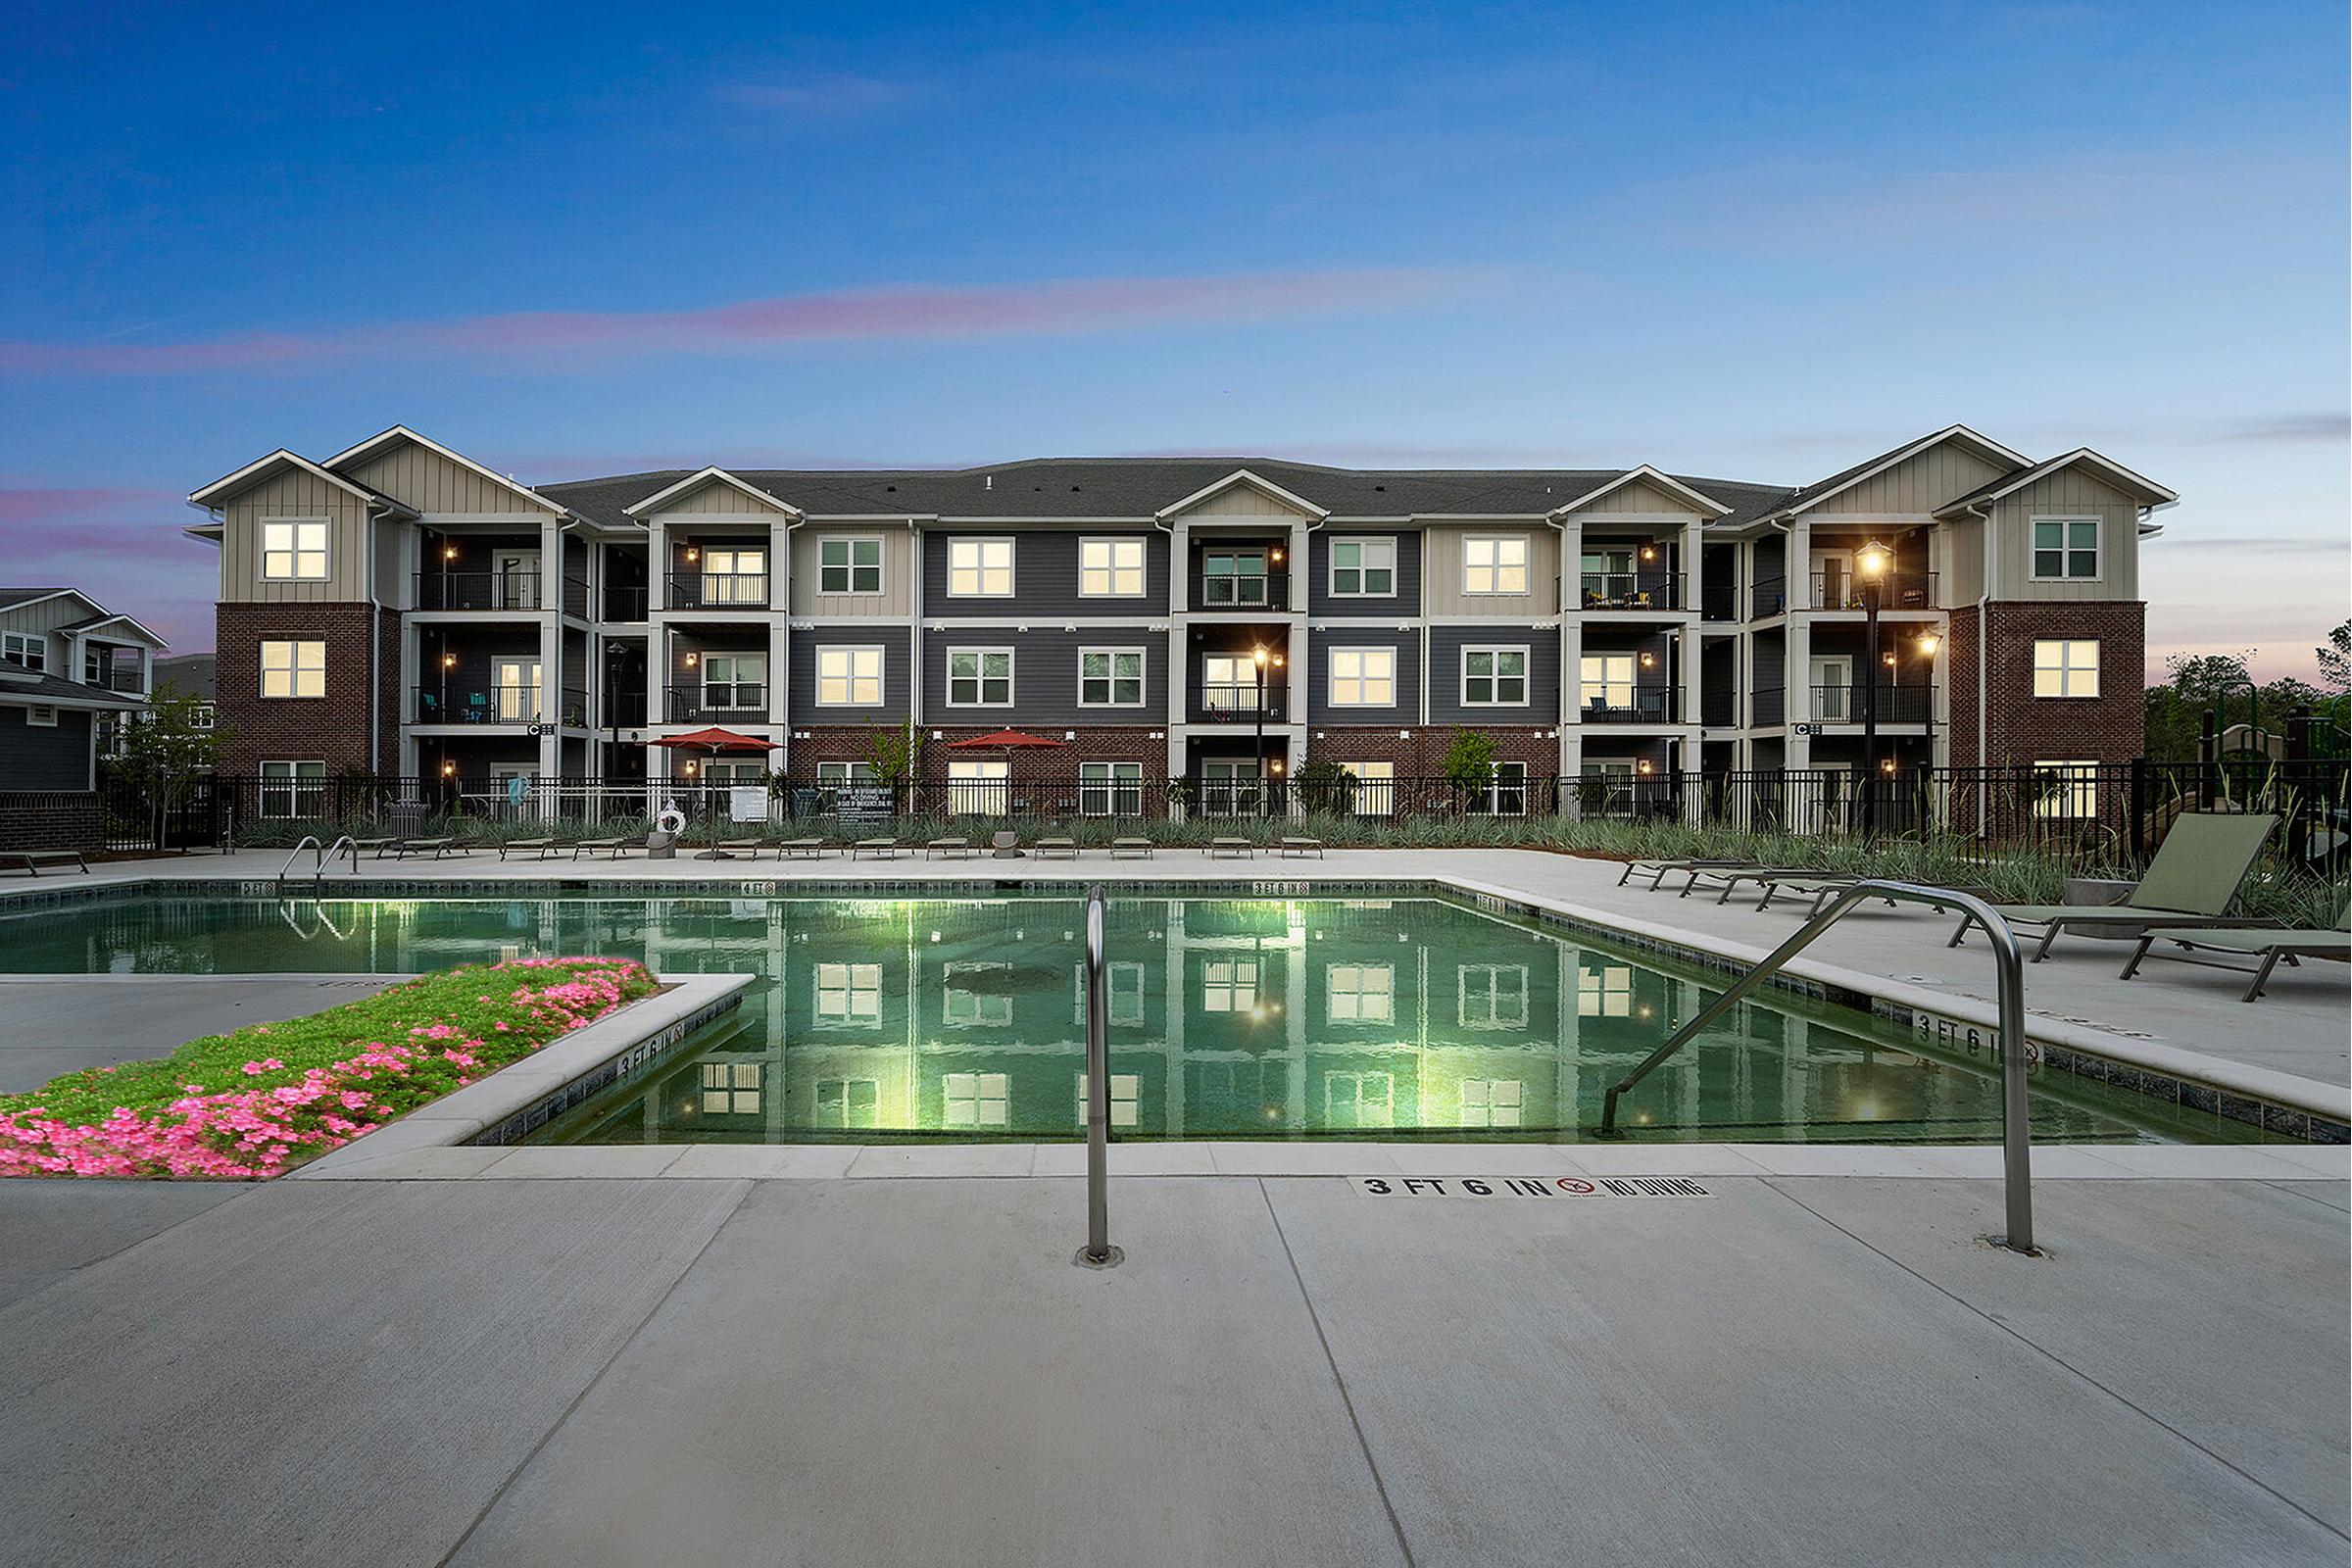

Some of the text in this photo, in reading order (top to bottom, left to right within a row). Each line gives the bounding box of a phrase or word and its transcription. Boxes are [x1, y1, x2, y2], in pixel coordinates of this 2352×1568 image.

[744, 883, 750, 894] 4
[1254, 882, 1262, 895] 3
[1919, 1014, 1930, 1033] 3
[1967, 1028, 1980, 1047] 6
[621, 1056, 629, 1075] 3
[650, 1040, 657, 1057] 6
[662, 1029, 671, 1051] IN
[1364, 1179, 1709, 1197] 3 FT 6 IN NO DIVING
